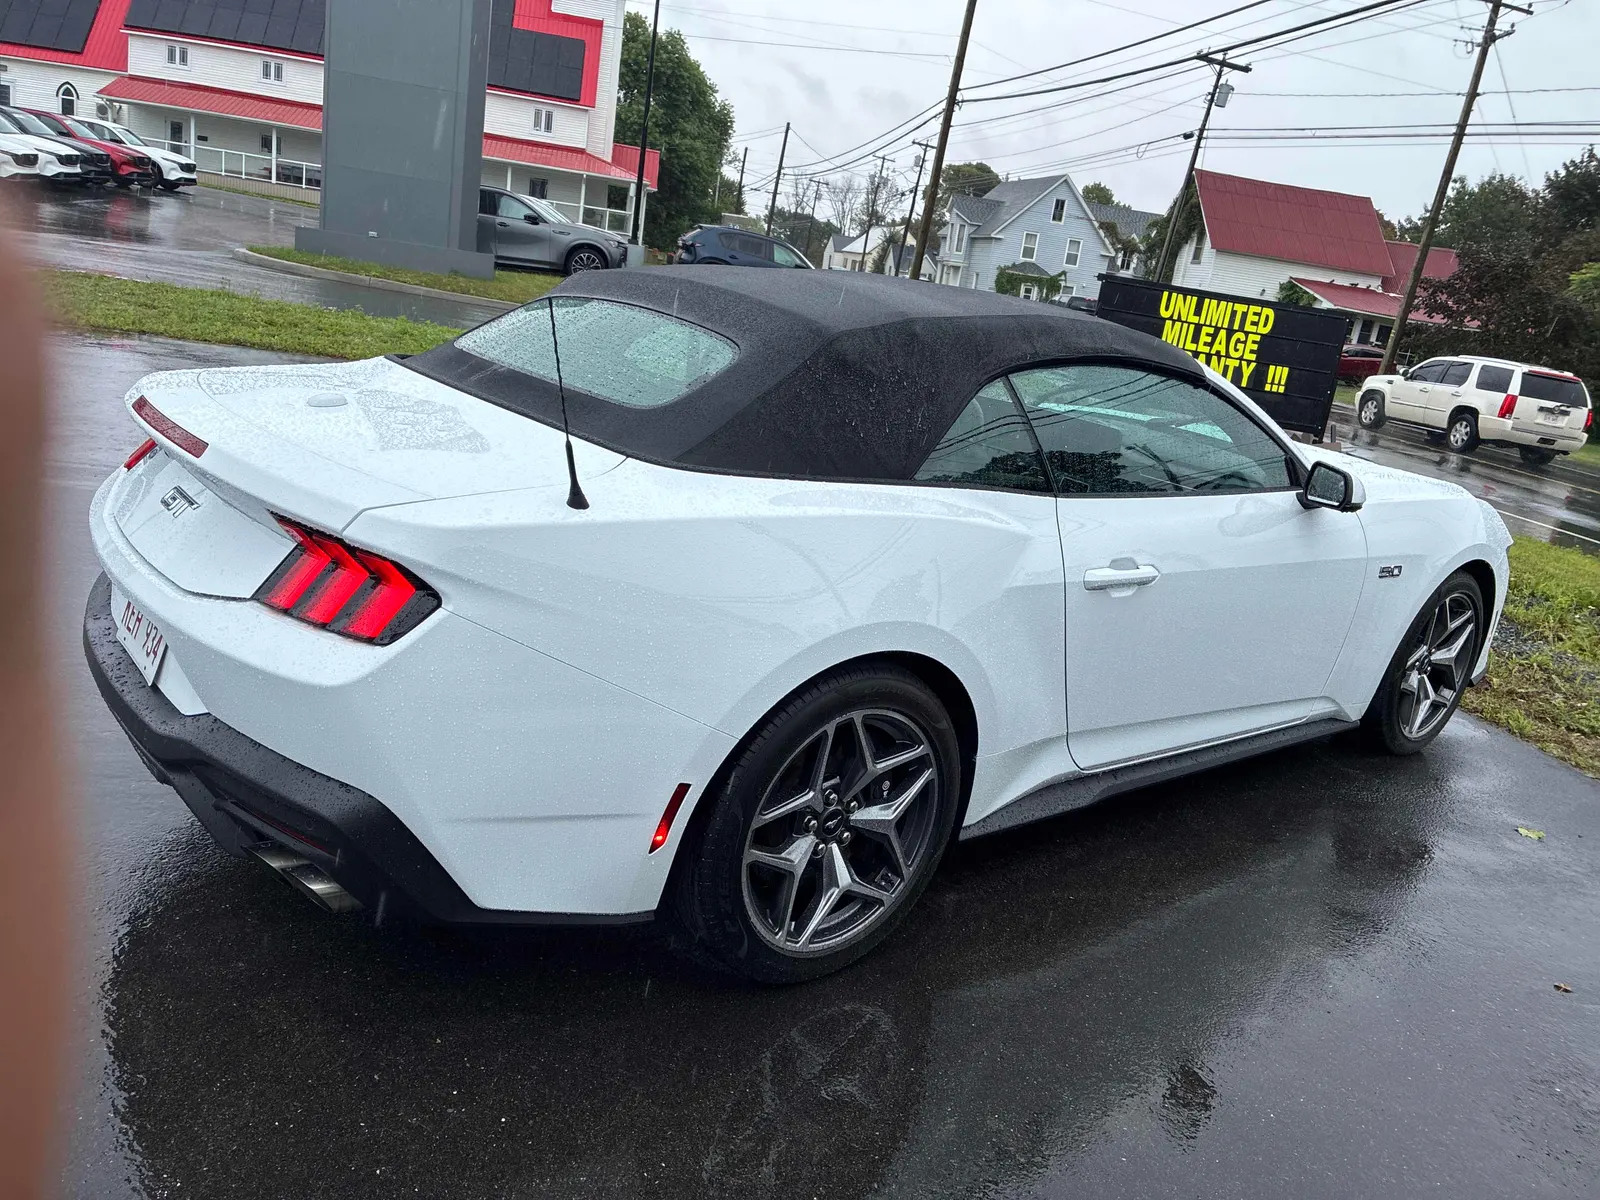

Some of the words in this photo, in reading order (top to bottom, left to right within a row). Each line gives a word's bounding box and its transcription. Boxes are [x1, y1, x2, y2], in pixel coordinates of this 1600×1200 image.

[1159, 291, 1275, 335] UNLIMITED
[1161, 319, 1262, 361] MILEAGE
[1264, 365, 1289, 394] !!!
[160, 485, 201, 519] GT
[142, 620, 164, 666] 934
